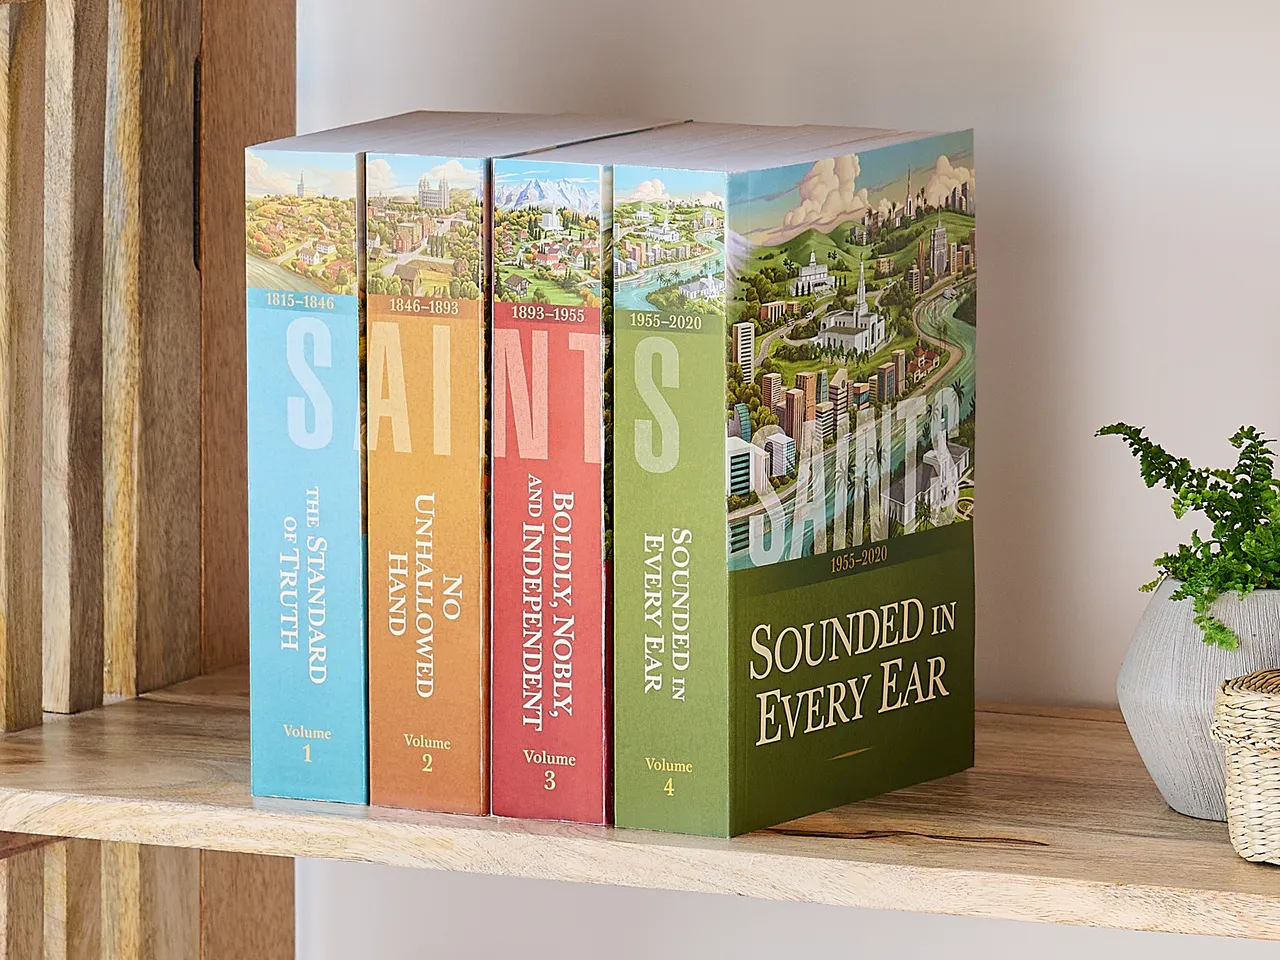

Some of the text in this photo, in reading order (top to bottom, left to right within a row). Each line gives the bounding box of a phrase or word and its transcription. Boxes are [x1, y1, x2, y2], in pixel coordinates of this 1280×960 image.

[749, 387, 960, 567] SAINTS
[279, 516, 300, 651] OF TRUTH
[305, 485, 328, 684] THE STANDARD
[388, 551, 408, 636] HAND
[415, 492, 436, 698] UNHALLOWED
[442, 574, 463, 620] NO
[522, 473, 545, 732] AND INDEPENDENT
[548, 490, 575, 718] BOLDLY, NOBLY,
[643, 532, 665, 694] EVERY EAR
[671, 527, 693, 702] SOUNDED IN
[749, 598, 957, 680] SOUNDED IN
[283, 724, 332, 740] Volume
[403, 733, 451, 750] Volume
[755, 656, 950, 746] EVERY EAR
[303, 744, 313, 763] 1
[422, 753, 433, 772] 2
[522, 749, 576, 767] Volume
[543, 770, 556, 790] 3
[644, 757, 693, 773] Volume
[663, 777, 675, 796] 4
